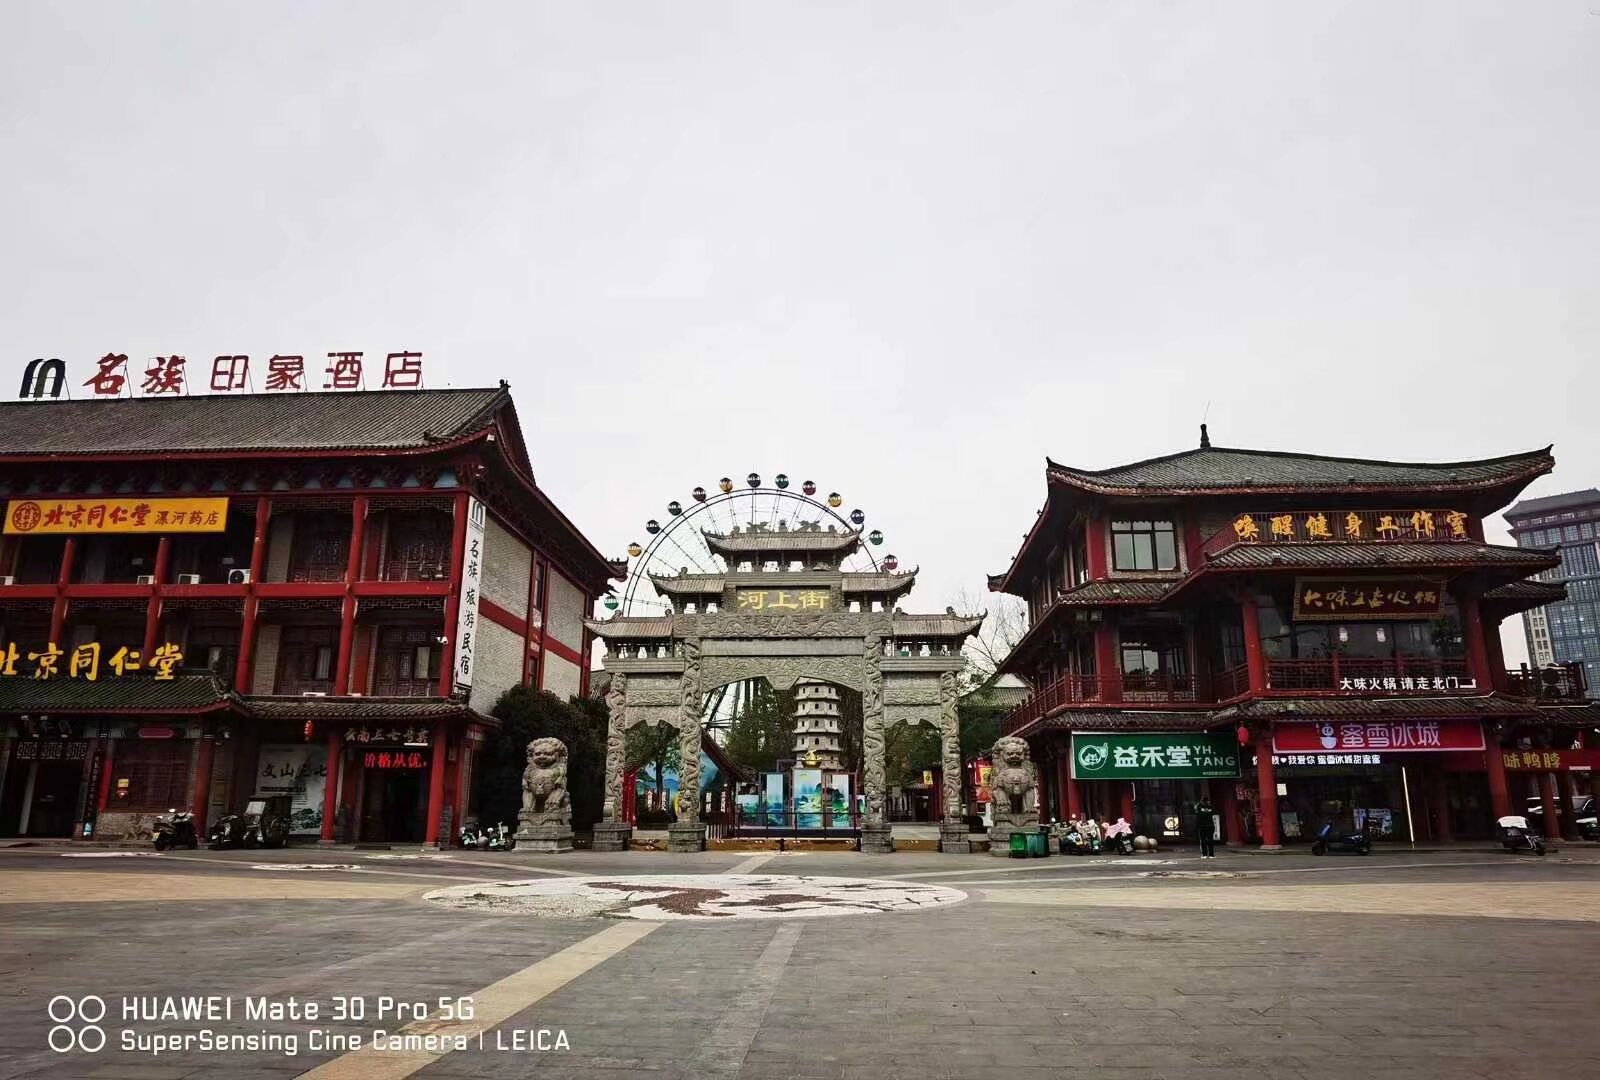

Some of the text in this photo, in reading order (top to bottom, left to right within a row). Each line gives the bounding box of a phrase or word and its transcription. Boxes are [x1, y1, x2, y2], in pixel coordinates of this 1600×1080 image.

[83, 352, 422, 395] 名族印象酒店
[43, 503, 151, 528] 北京同仁堂
[154, 510, 219, 526] 漯河药店
[1233, 511, 1468, 538] 唤醒健身工作室
[460, 539, 480, 675] 名族旅游民宿
[738, 591, 829, 609] 河上街
[0, 642, 183, 681] 北京同仁堂
[1341, 722, 1440, 747] 蜜雪冰城
[1113, 745, 1193, 768] 益禾堂
[1193, 756, 1236, 767] TANG
